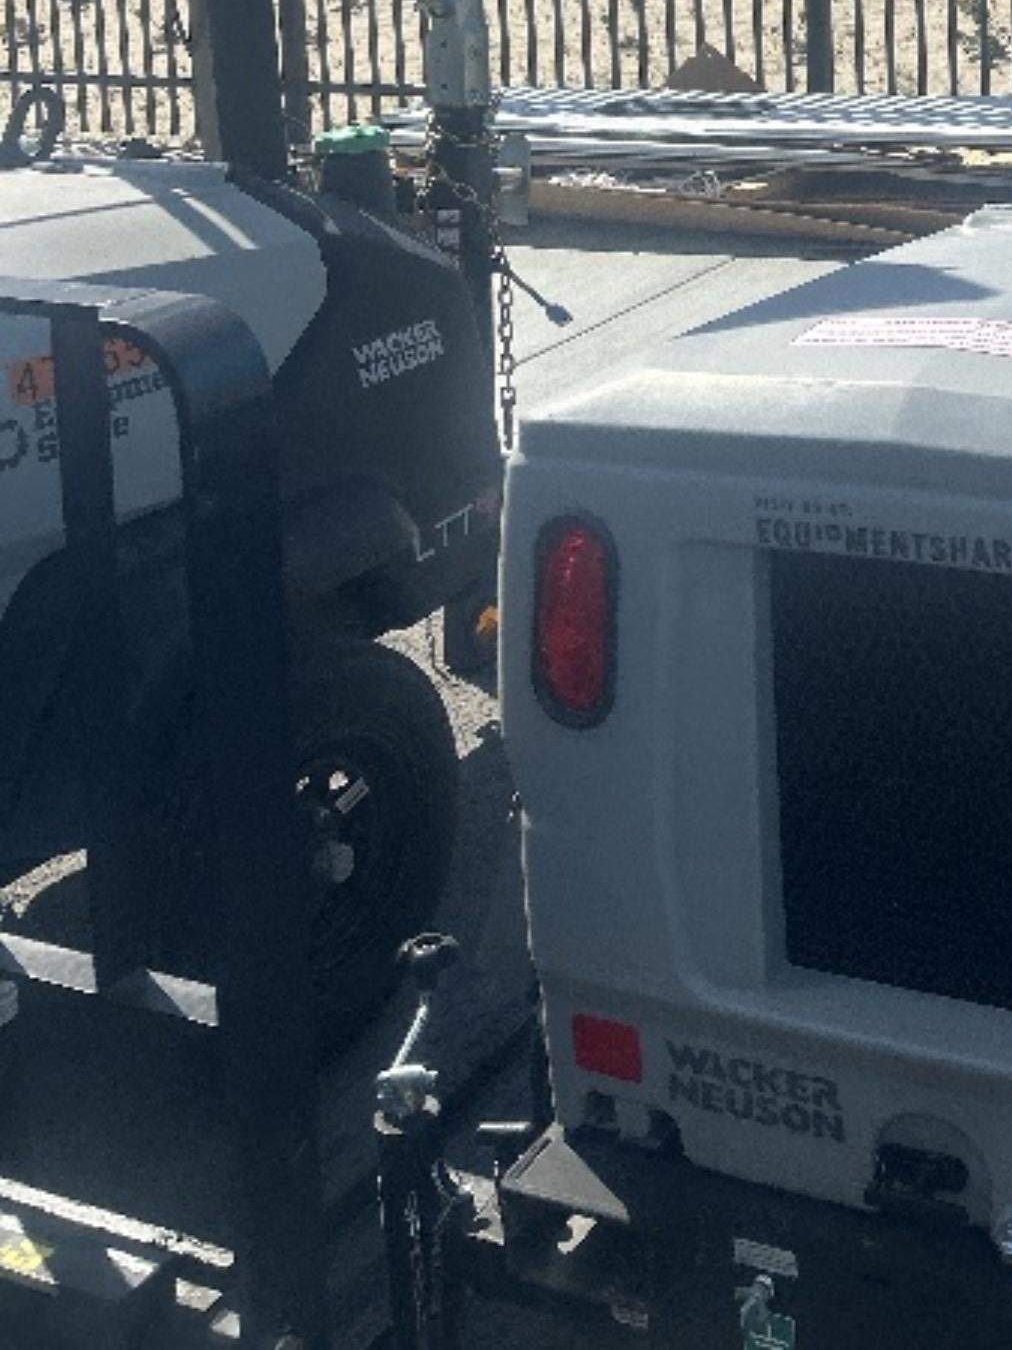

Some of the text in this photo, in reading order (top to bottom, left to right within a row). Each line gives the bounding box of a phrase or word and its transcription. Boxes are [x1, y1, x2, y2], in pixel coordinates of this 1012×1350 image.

[352, 320, 441, 364] WACKER
[359, 340, 445, 388] NEUSON
[664, 1038, 843, 1112] WACKER
[668, 1072, 846, 1144] NEUSON
